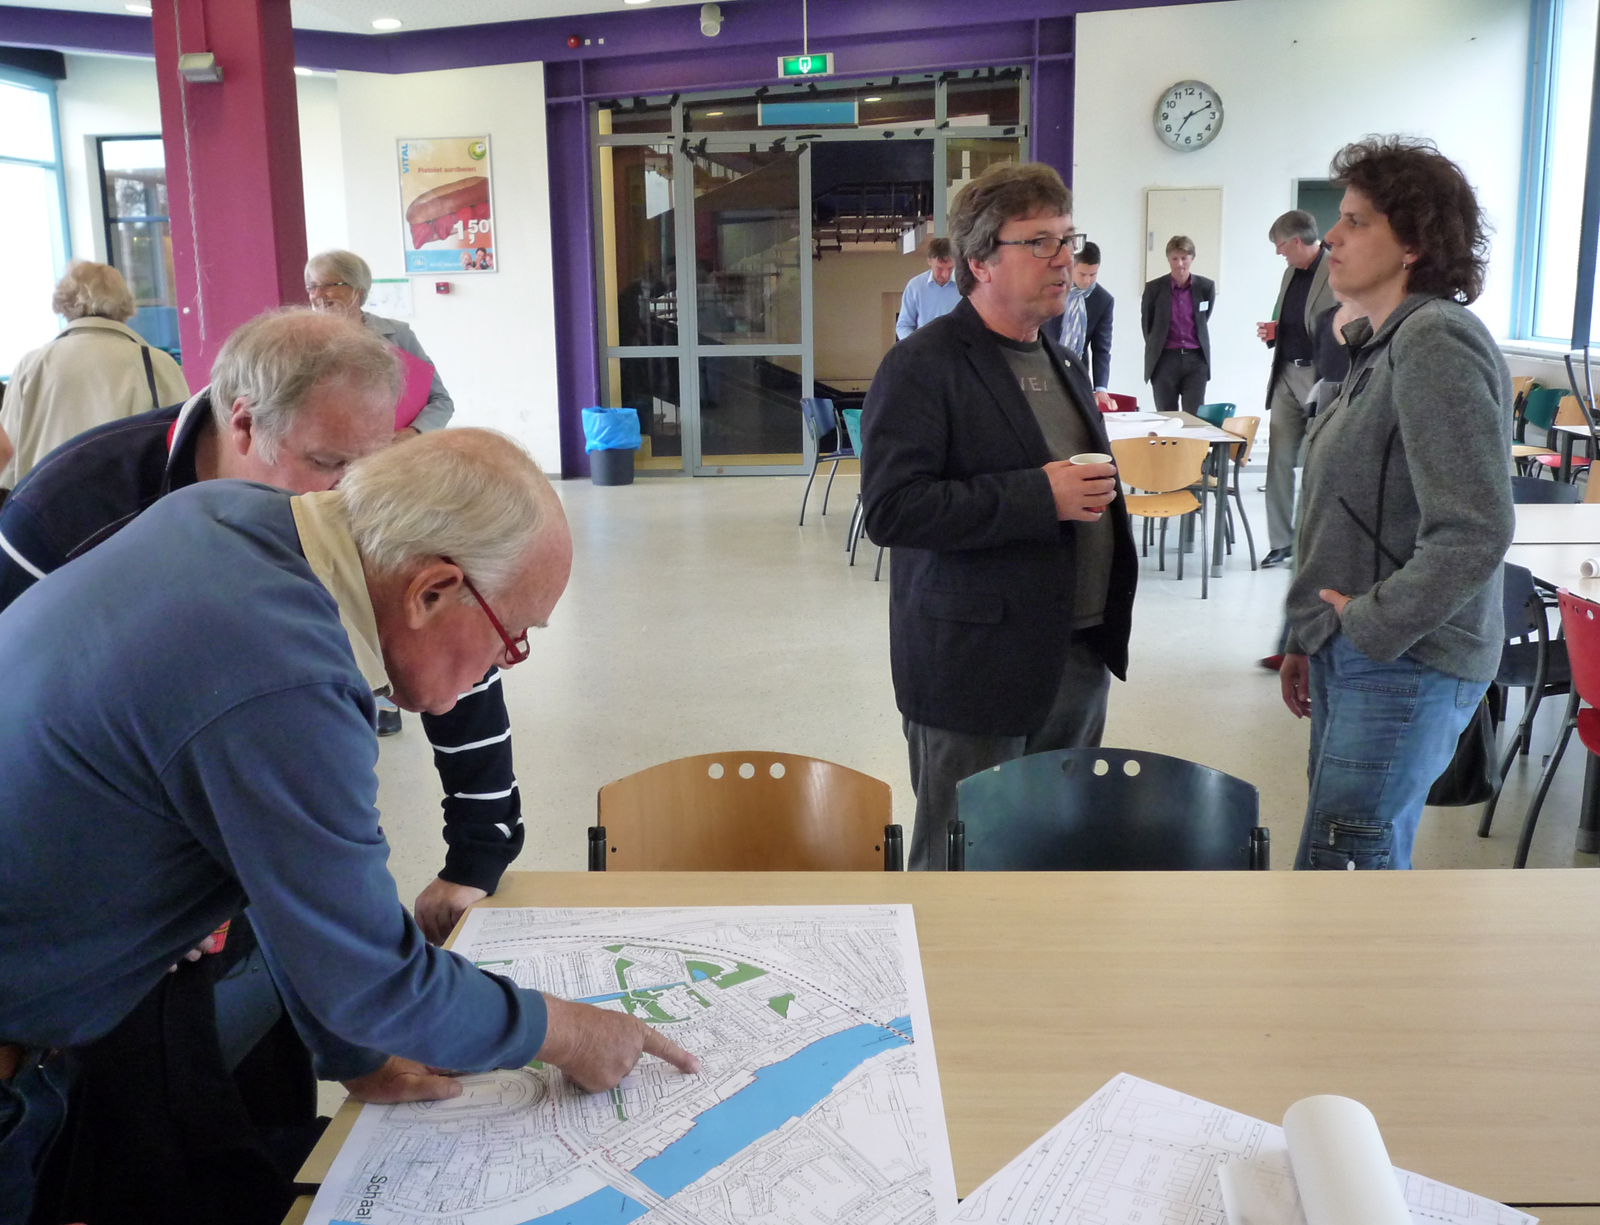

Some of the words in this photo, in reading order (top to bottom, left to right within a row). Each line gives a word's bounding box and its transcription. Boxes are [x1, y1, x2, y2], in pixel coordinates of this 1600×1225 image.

[1184, 88, 1195, 96] 12
[1166, 100, 1176, 108] 10
[1162, 112, 1169, 120] 9
[1165, 124, 1172, 132] 8
[1174, 133, 1180, 141] 7
[1184, 136, 1191, 144] 6
[1196, 133, 1203, 141] 5
[401, 143, 410, 174] VITAL
[453, 219, 490, 244] 1,50
[355, 1176, 388, 1219] Schaal
